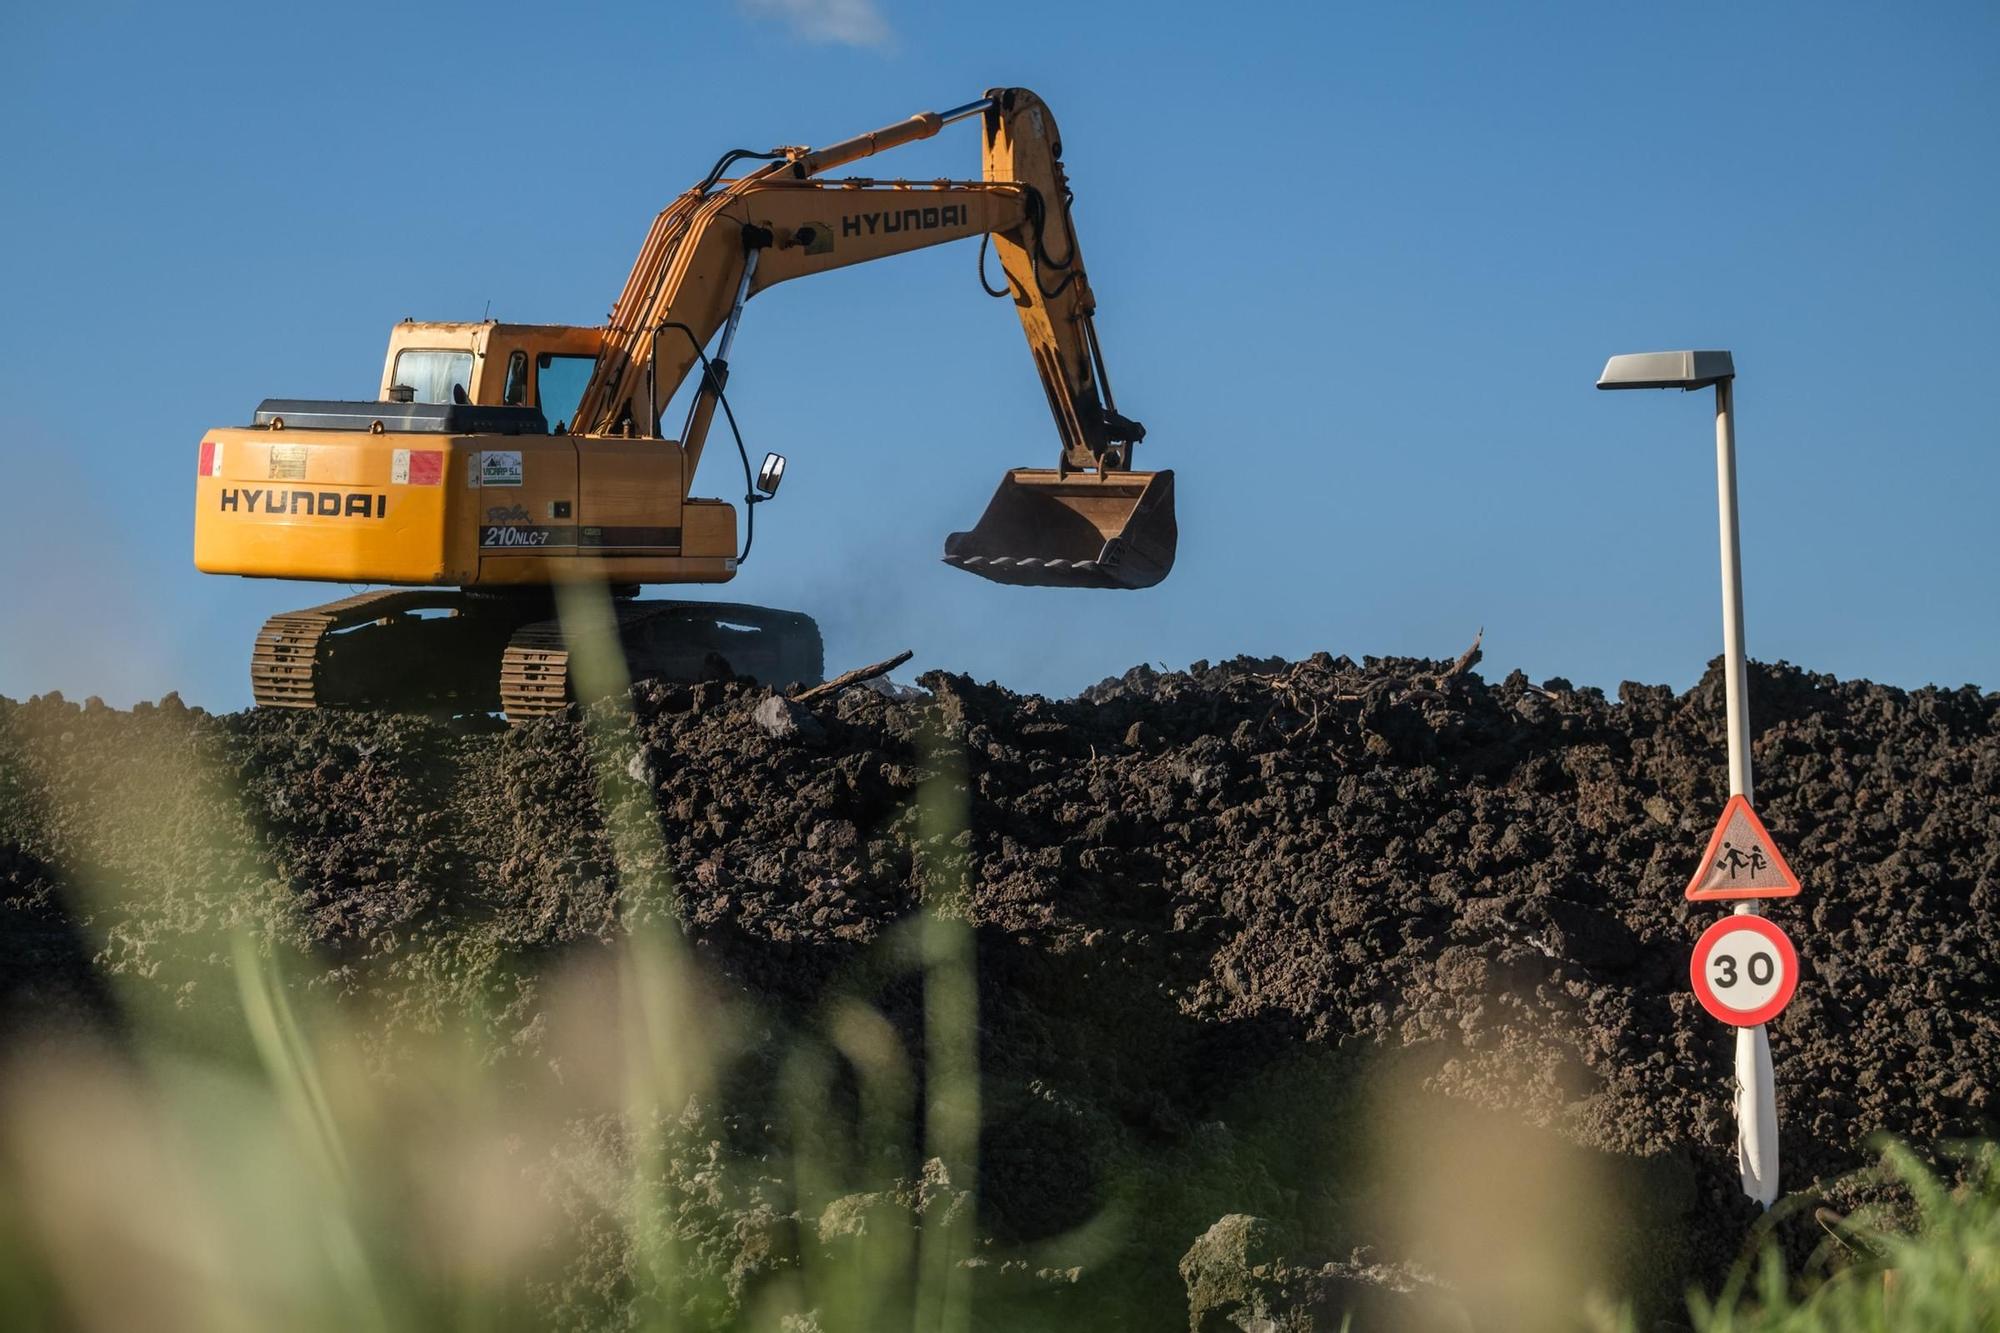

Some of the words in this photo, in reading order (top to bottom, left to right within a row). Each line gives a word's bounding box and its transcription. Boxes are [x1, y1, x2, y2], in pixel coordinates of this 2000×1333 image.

[842, 204, 968, 238] HYUNDAI
[221, 488, 387, 519] HYUNDAI
[485, 527, 549, 546] 210NLC-7
[1713, 951, 1775, 989] 30
